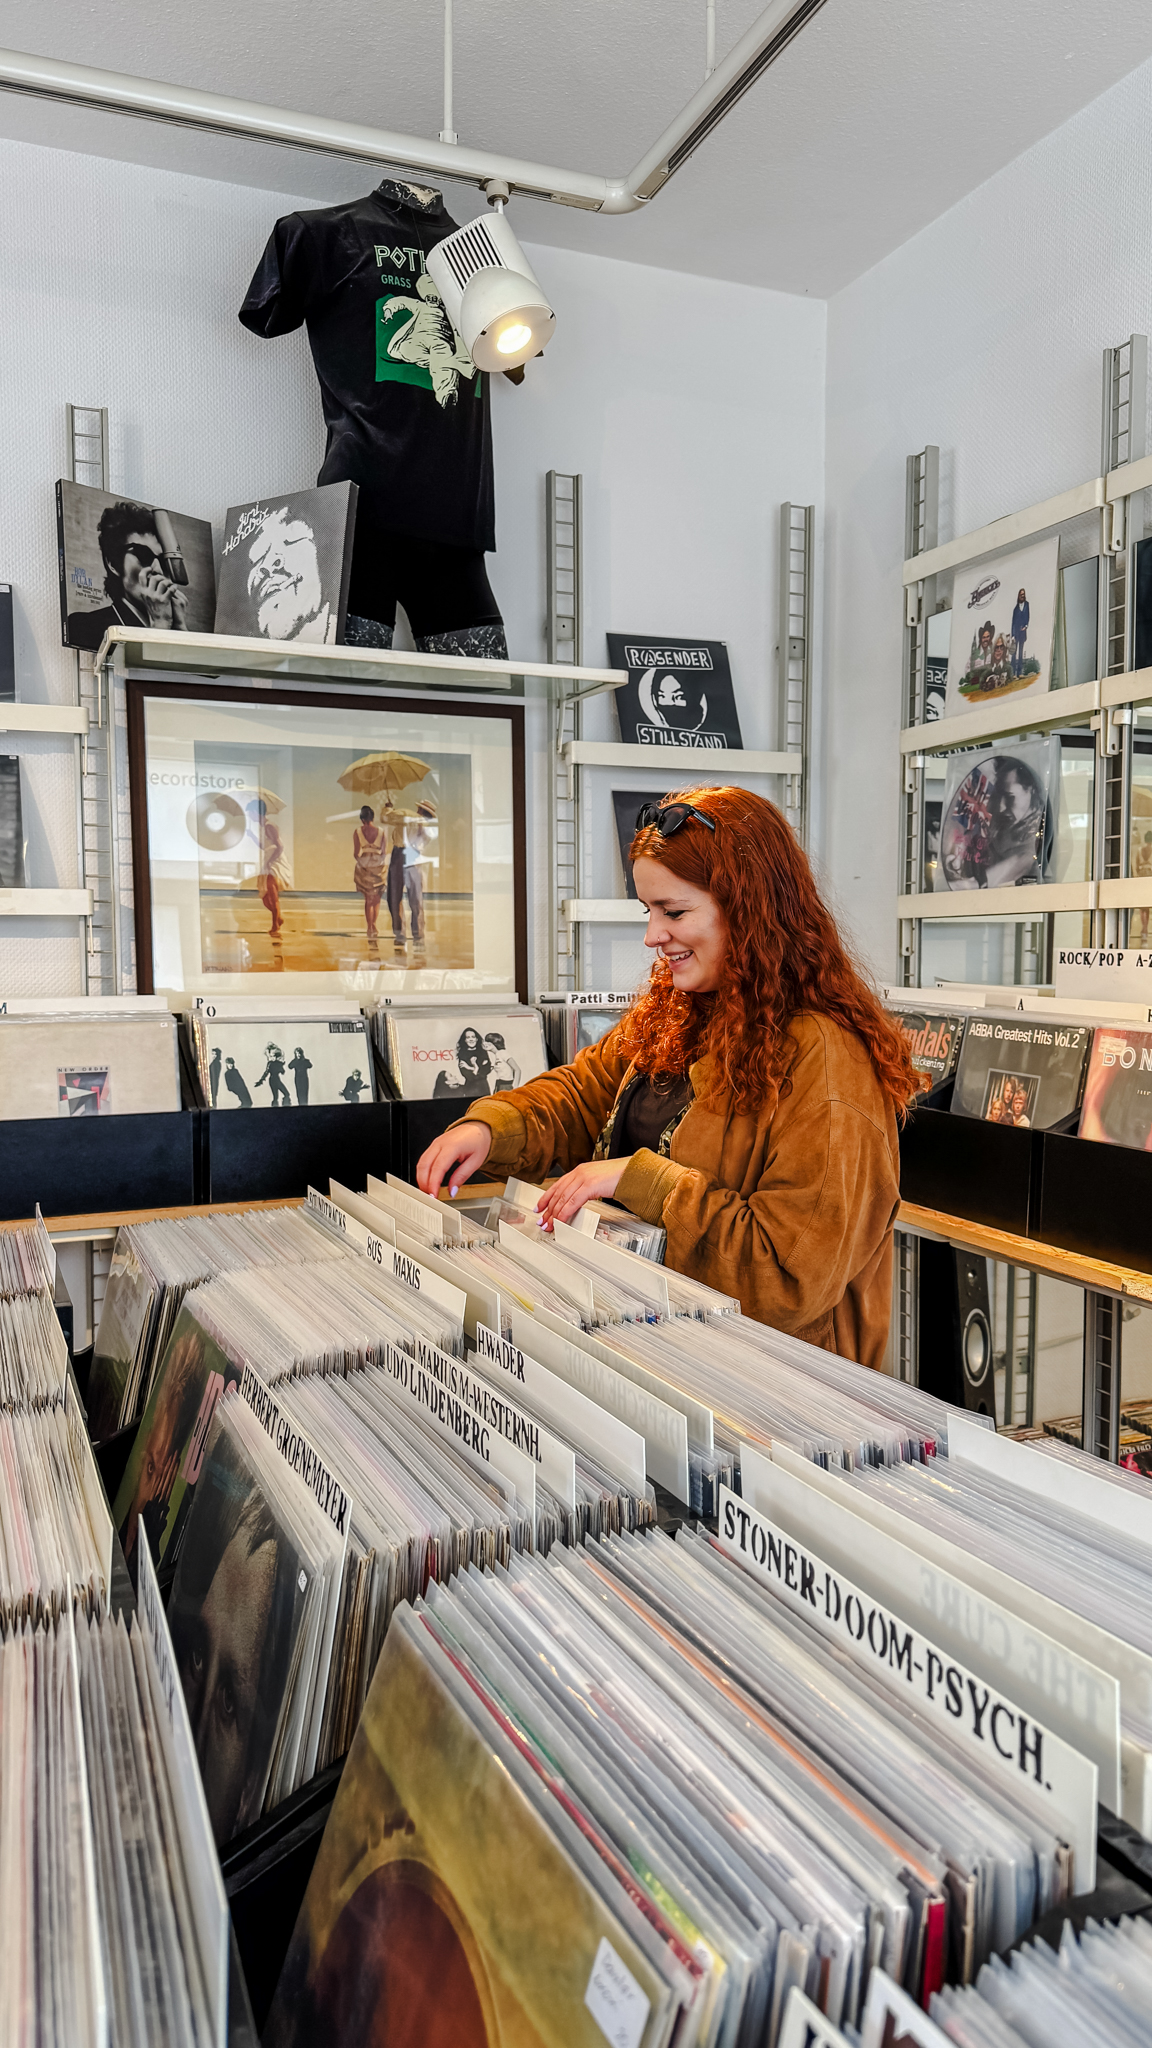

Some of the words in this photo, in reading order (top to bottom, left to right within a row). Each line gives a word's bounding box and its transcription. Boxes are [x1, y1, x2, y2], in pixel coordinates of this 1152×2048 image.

[381, 274, 412, 289] GRASS
[196, 997, 204, 1009] P
[571, 993, 602, 1004] Patti
[1017, 998, 1024, 1011] A
[893, 1016, 951, 1059] ndals
[994, 1025, 1032, 1043] Greatest
[1033, 1029, 1053, 1045] Hits
[412, 1049, 454, 1062] ROCHES
[911, 1056, 946, 1073] uickening
[393, 1252, 421, 1290] MAXIS
[418, 1341, 458, 1395] MARIUS
[386, 1343, 408, 1388] UDO
[410, 1363, 490, 1463] LINDENBERG
[241, 1366, 279, 1440] HERBERT
[276, 1417, 348, 1537] GROENEMEYER
[724, 1500, 1053, 1791] STONER-DOOM-PSYCH.
